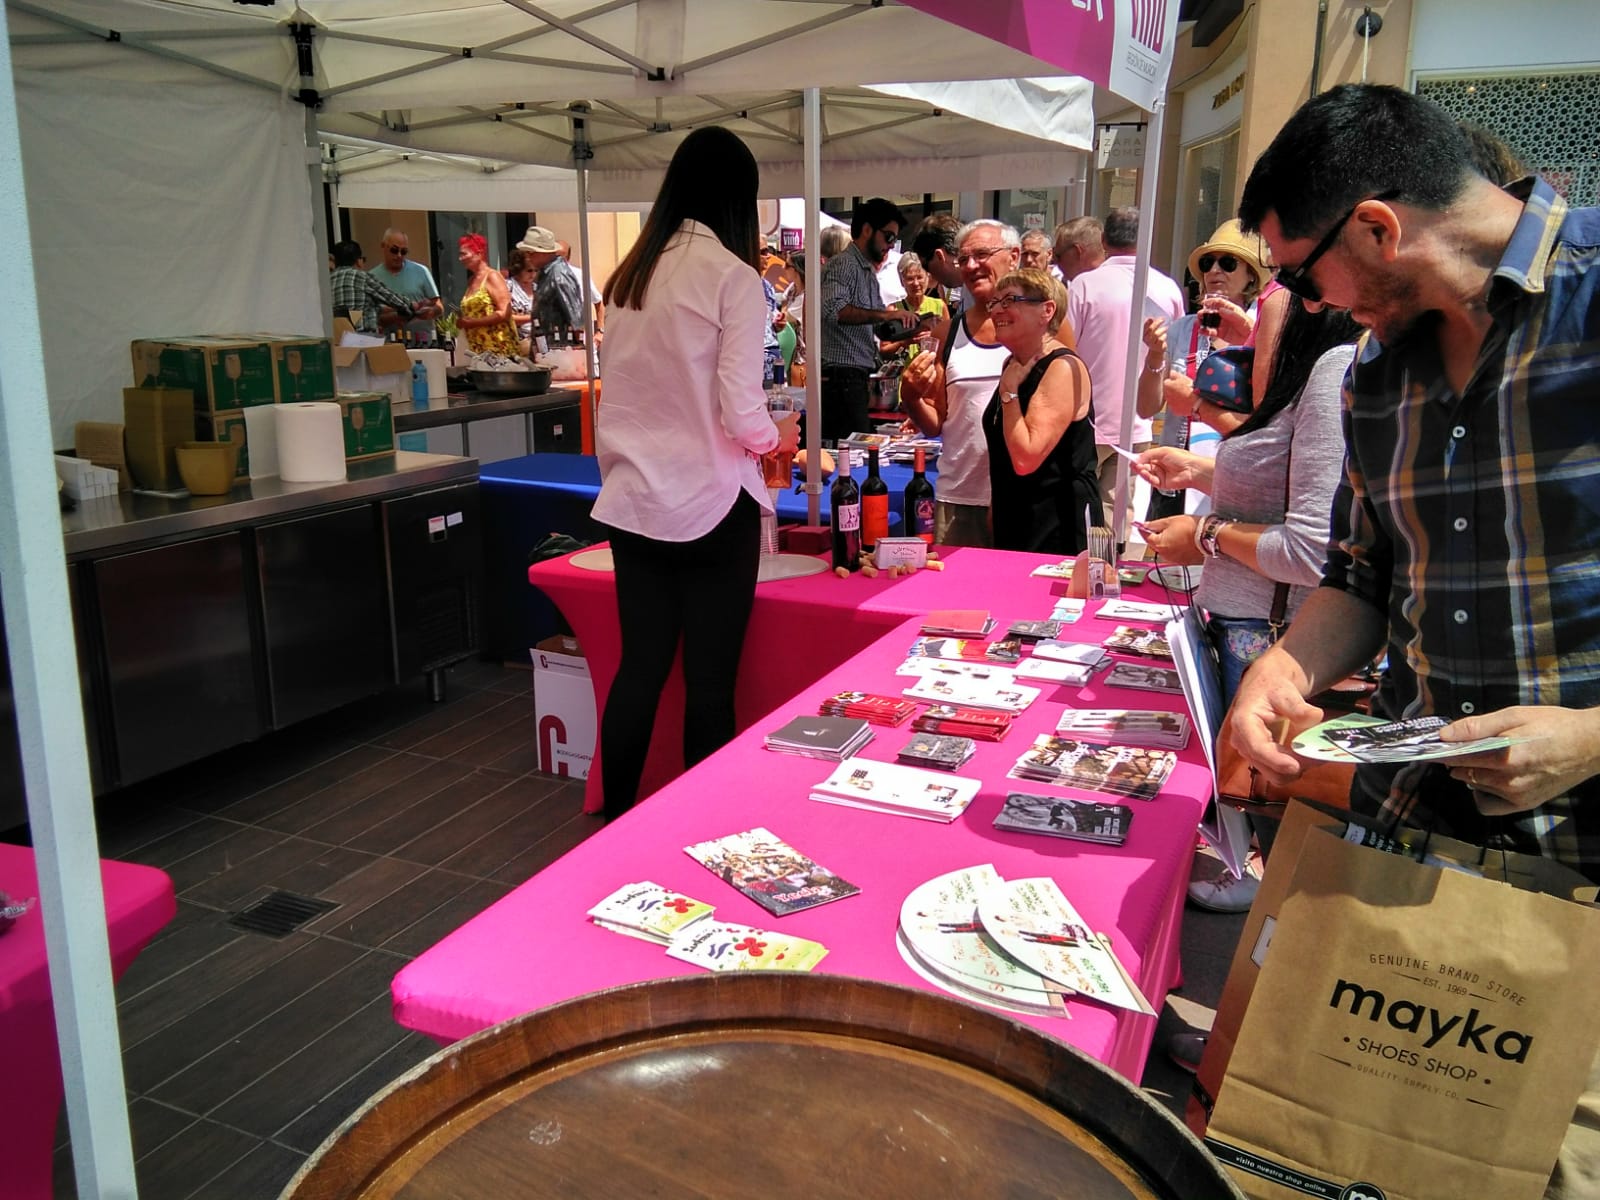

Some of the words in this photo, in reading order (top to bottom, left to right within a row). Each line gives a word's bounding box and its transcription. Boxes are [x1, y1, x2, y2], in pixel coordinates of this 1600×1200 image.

[1104, 138, 1141, 147] ZARA
[1104, 149, 1142, 157] HOME
[1369, 953, 1430, 970] GENUINE
[1439, 964, 1480, 984] BRAND
[1486, 980, 1527, 1007] STORE
[1423, 977, 1441, 990] EST.
[1446, 983, 1468, 996] 1969
[1329, 978, 1534, 1064] mayka
[1356, 1037, 1420, 1067] SHOES
[1424, 1058, 1478, 1082] SHOP
[1285, 1174, 1303, 1186] shop
[1304, 1182, 1327, 1193] online
